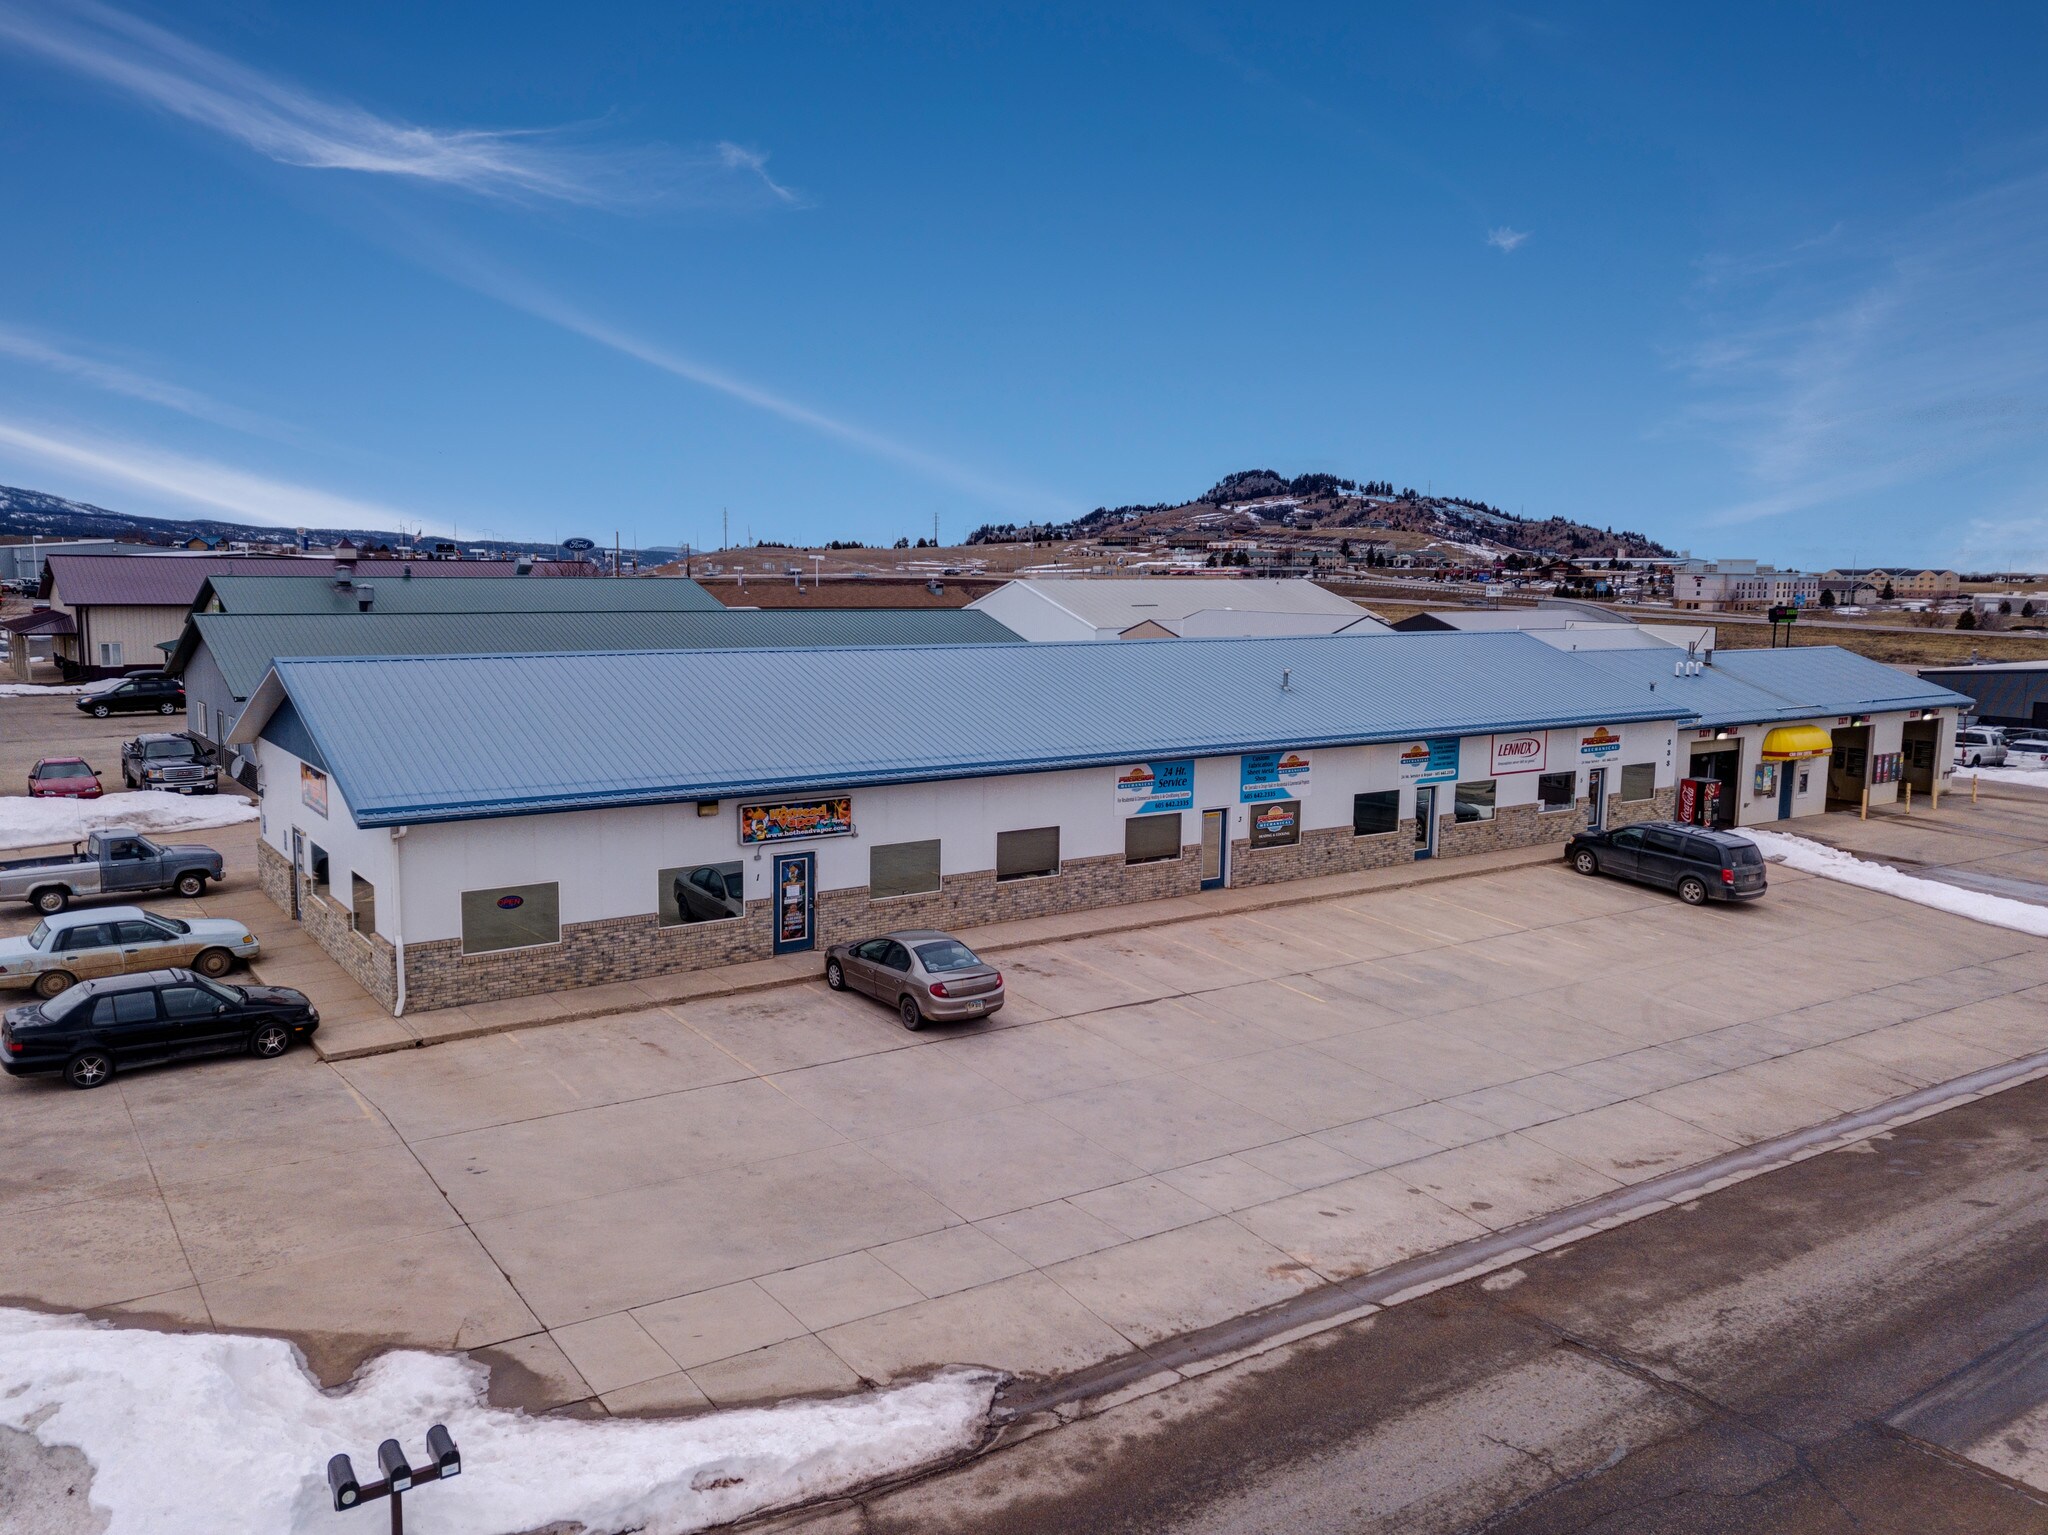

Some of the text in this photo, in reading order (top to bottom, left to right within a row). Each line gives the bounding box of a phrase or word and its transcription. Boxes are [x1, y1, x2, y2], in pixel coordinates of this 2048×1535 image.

[570, 540, 589, 549] Ford
[1582, 734, 1620, 746] PRECISION
[1498, 741, 1533, 757] LENNOX
[1583, 745, 1618, 753] MECHANICAL
[1163, 767, 1173, 777] 24
[1158, 778, 1188, 788] Service
[1254, 791, 1276, 799] 642.2335
[1166, 800, 1189, 808] 642.2335
[1260, 820, 1292, 828] MECHANICAL
[766, 825, 847, 839] www.hotheadvapor.com
